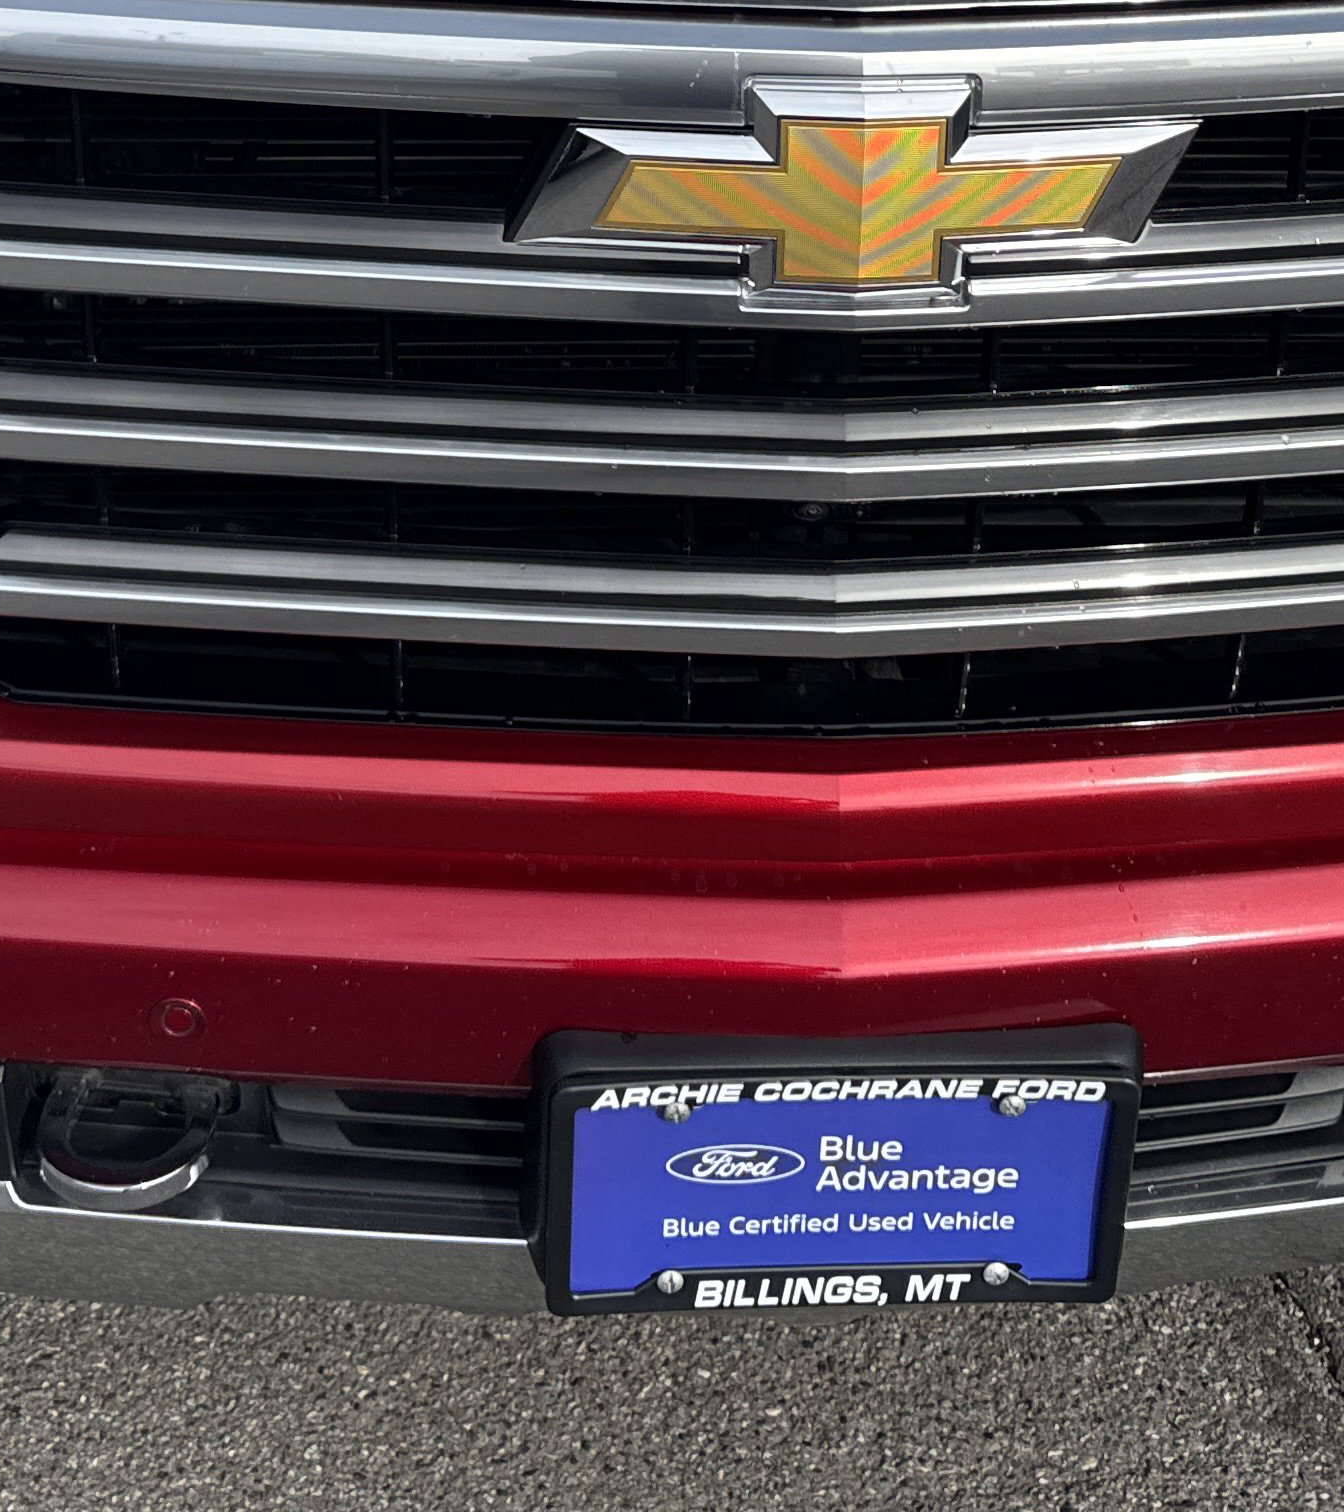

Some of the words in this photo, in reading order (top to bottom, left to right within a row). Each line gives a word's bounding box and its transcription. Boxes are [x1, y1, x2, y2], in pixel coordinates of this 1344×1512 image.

[590, 1082, 745, 1113] ARCHIE
[753, 1078, 984, 1103] COCHRANE
[991, 1078, 1107, 1103] FORD
[819, 1134, 903, 1162] Blue
[691, 1148, 779, 1178] Ford
[815, 1164, 1019, 1195] Advantage
[662, 1217, 720, 1238] Blue
[728, 1212, 839, 1235] Certified
[849, 1210, 914, 1232] Used
[923, 1210, 1015, 1231] Vehicle
[694, 1274, 889, 1308] BILLINGS,
[904, 1273, 971, 1303] MT
